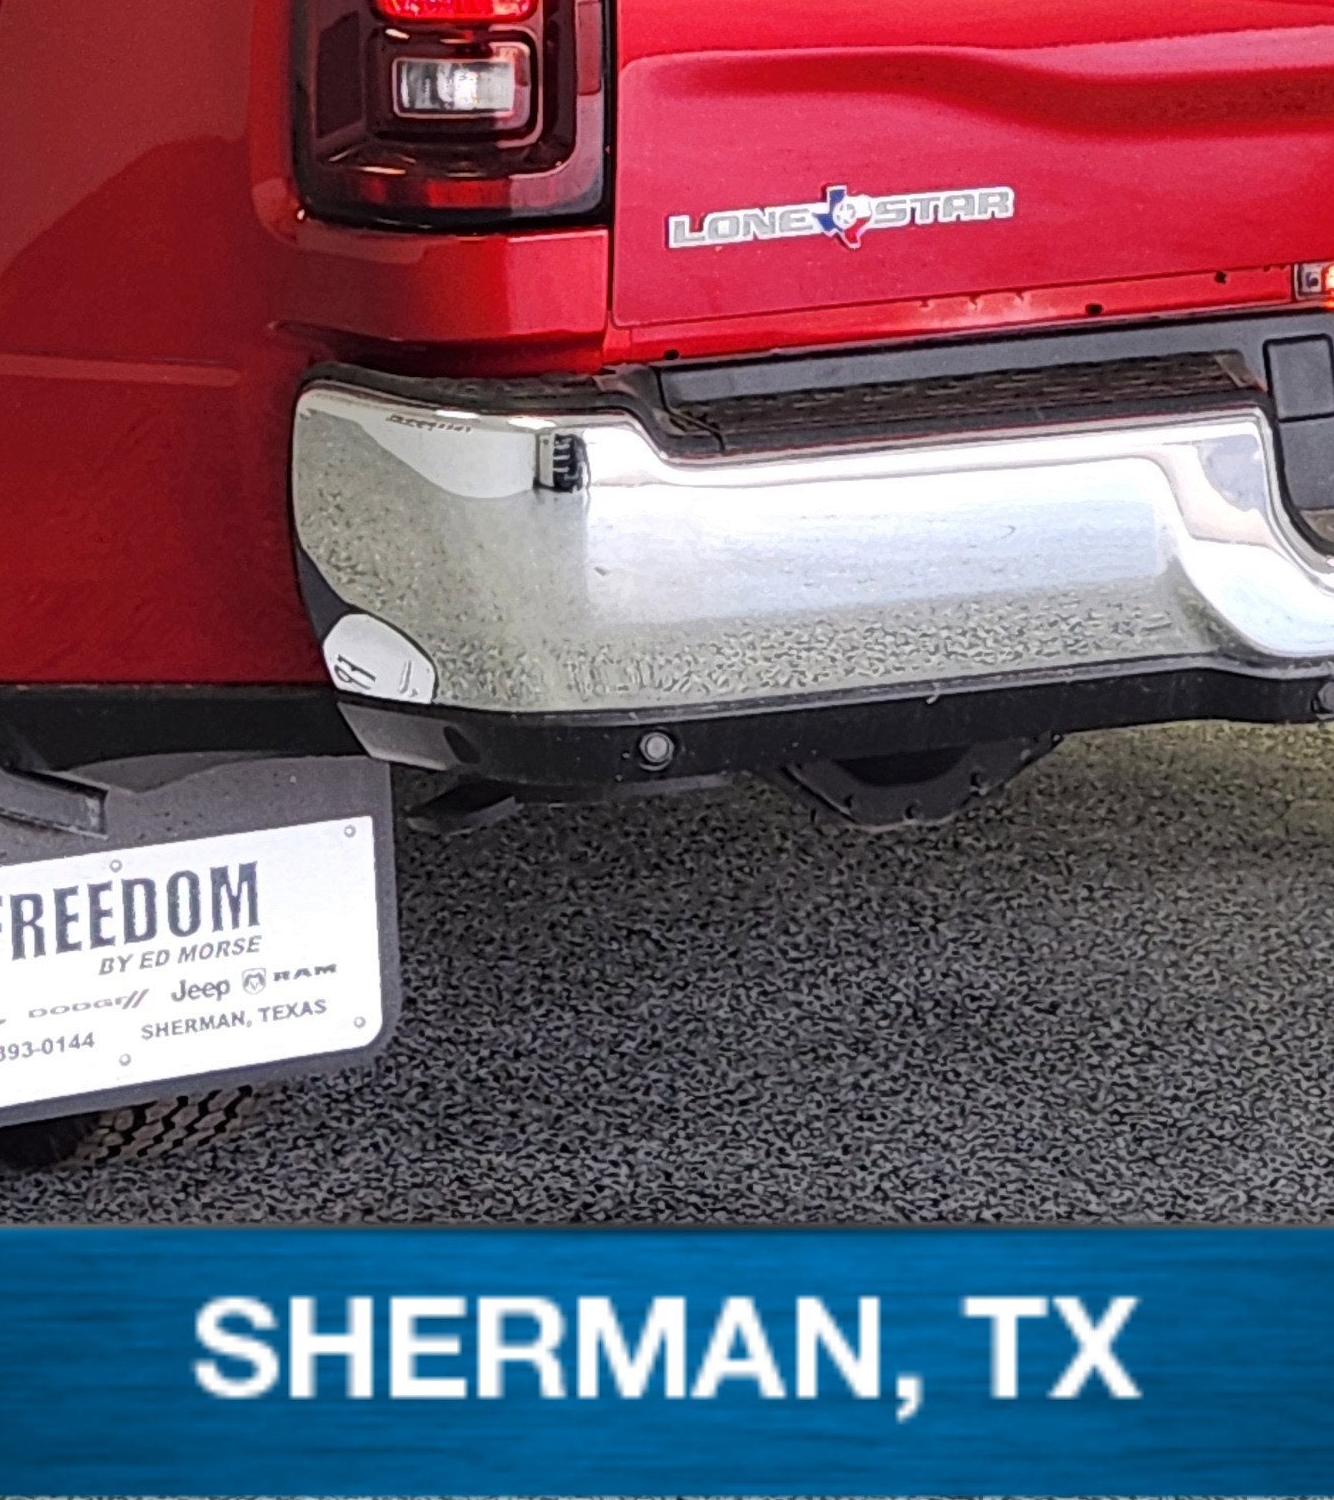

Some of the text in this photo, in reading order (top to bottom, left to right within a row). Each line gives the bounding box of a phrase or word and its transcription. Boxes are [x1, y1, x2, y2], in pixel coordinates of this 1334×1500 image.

[669, 186, 1014, 248] LONE STAR
[98, 934, 263, 976] BY ED MORSE
[171, 979, 231, 1003] Jeep
[273, 963, 338, 982] RAM
[140, 998, 328, 1041] SHERMAN, TEXAS
